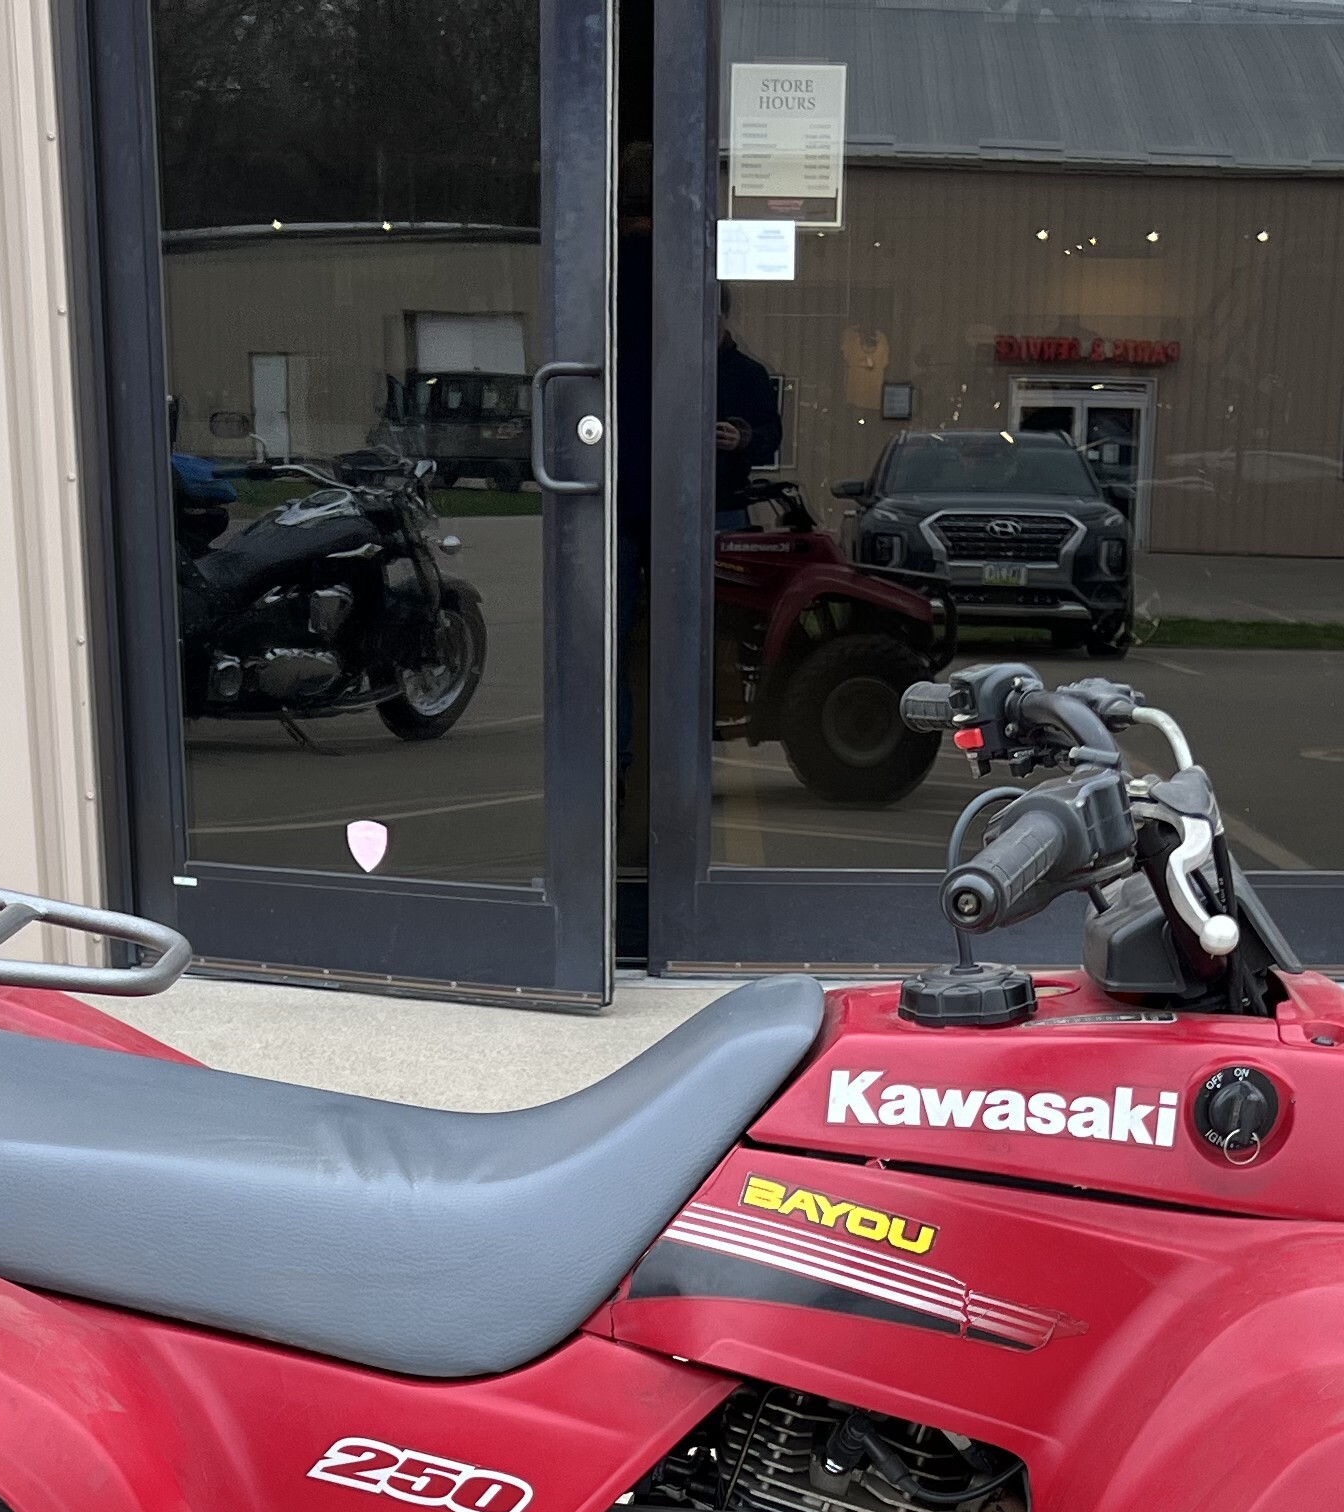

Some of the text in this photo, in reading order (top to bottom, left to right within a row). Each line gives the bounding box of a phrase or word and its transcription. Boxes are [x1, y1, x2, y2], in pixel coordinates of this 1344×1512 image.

[761, 79, 814, 93] STORE
[758, 96, 816, 110] HOURS
[1233, 1067, 1250, 1078] ON
[1205, 1072, 1224, 1090] OFF
[826, 1070, 1178, 1147] Kawasaki
[743, 1175, 936, 1255] BAYOU
